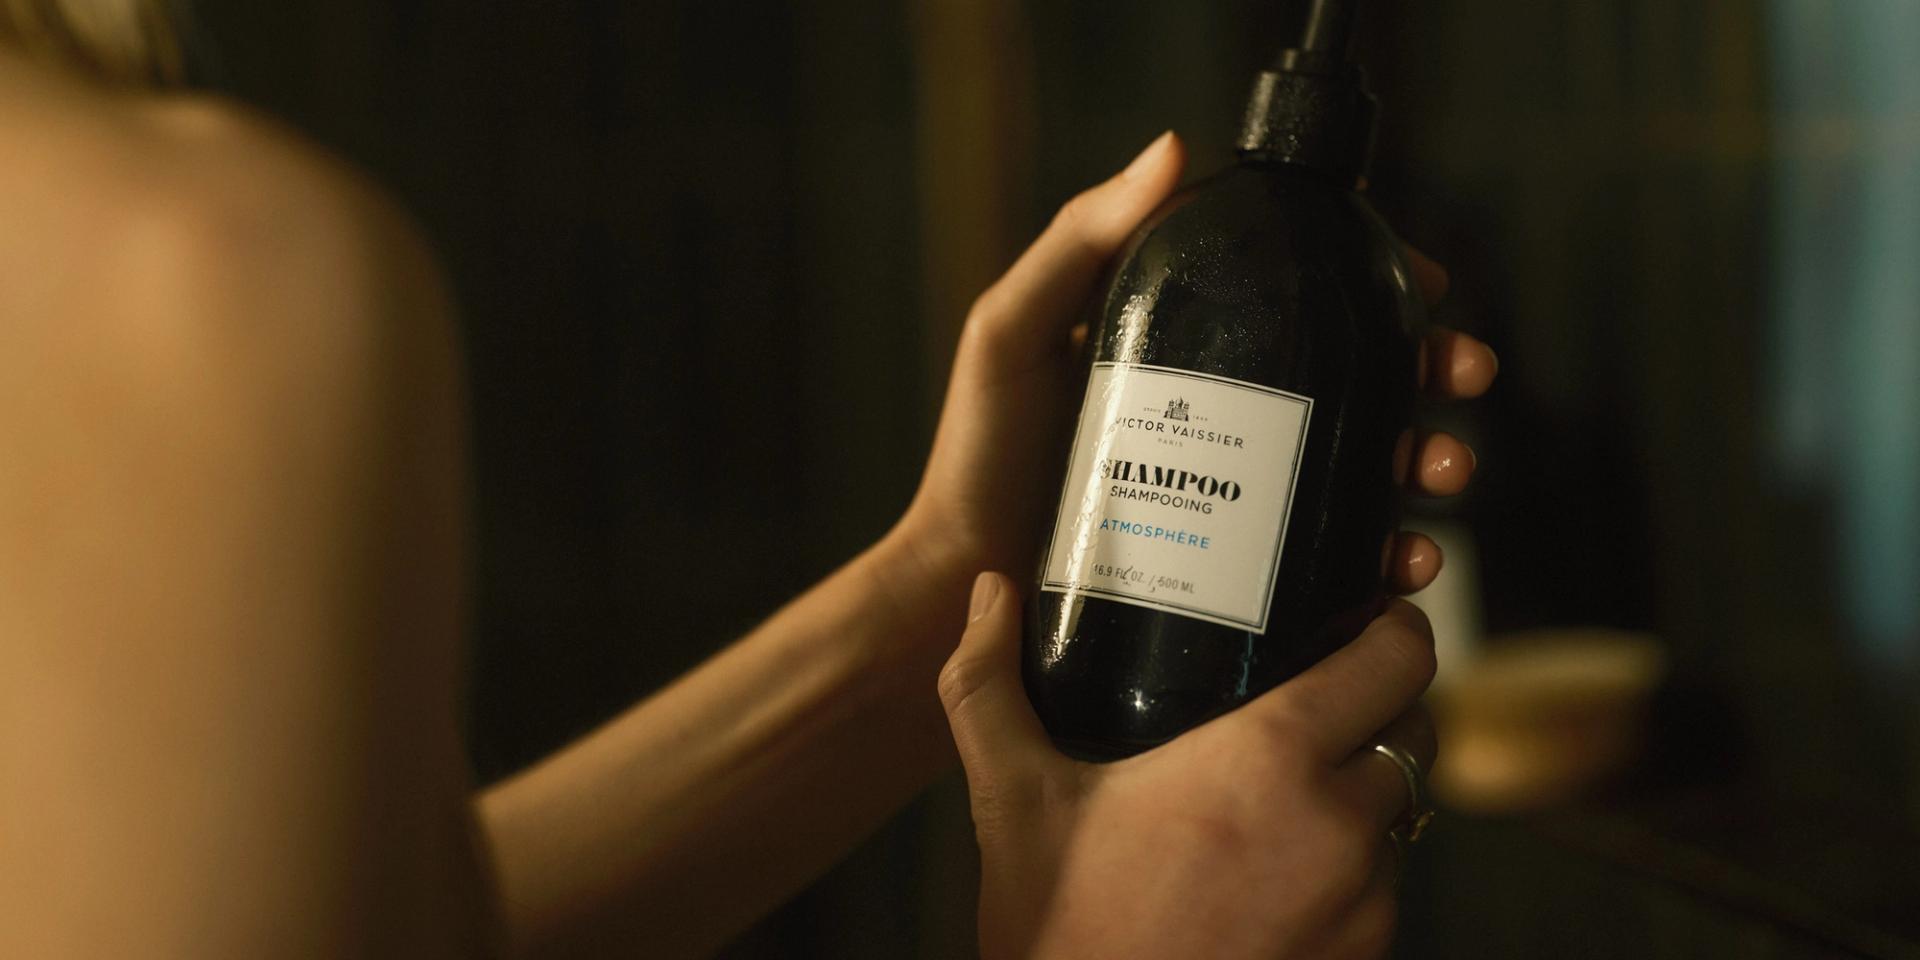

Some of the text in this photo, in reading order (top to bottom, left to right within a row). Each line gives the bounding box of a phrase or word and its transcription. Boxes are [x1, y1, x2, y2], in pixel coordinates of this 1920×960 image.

[1157, 437, 1184, 447] PARIS
[1172, 424, 1244, 448] VAISSIER
[1110, 485, 1213, 515] SHAMPOOING
[1100, 518, 1211, 550] ATMOSPHÈRE
[1094, 563, 1113, 577] 16.9
[1157, 576, 1179, 590] 500
[1181, 580, 1195, 594] ML
